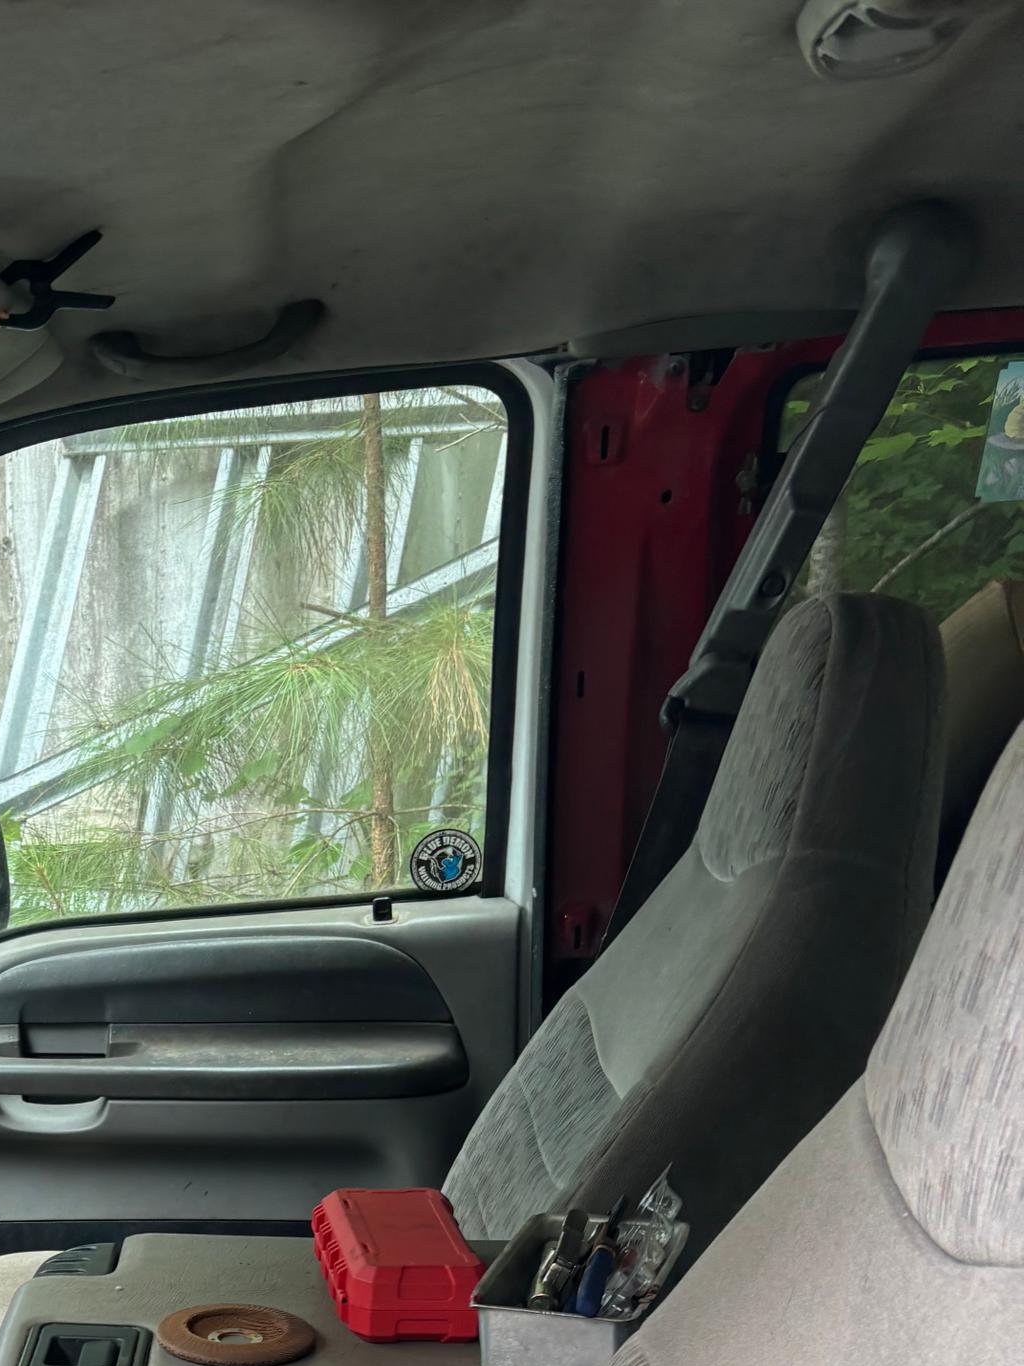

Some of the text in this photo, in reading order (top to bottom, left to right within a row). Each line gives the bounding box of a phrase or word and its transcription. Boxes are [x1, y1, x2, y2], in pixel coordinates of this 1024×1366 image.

[419, 836, 474, 860] BLUE DEMON
[418, 864, 474, 890] WELDING PRODUCTS
